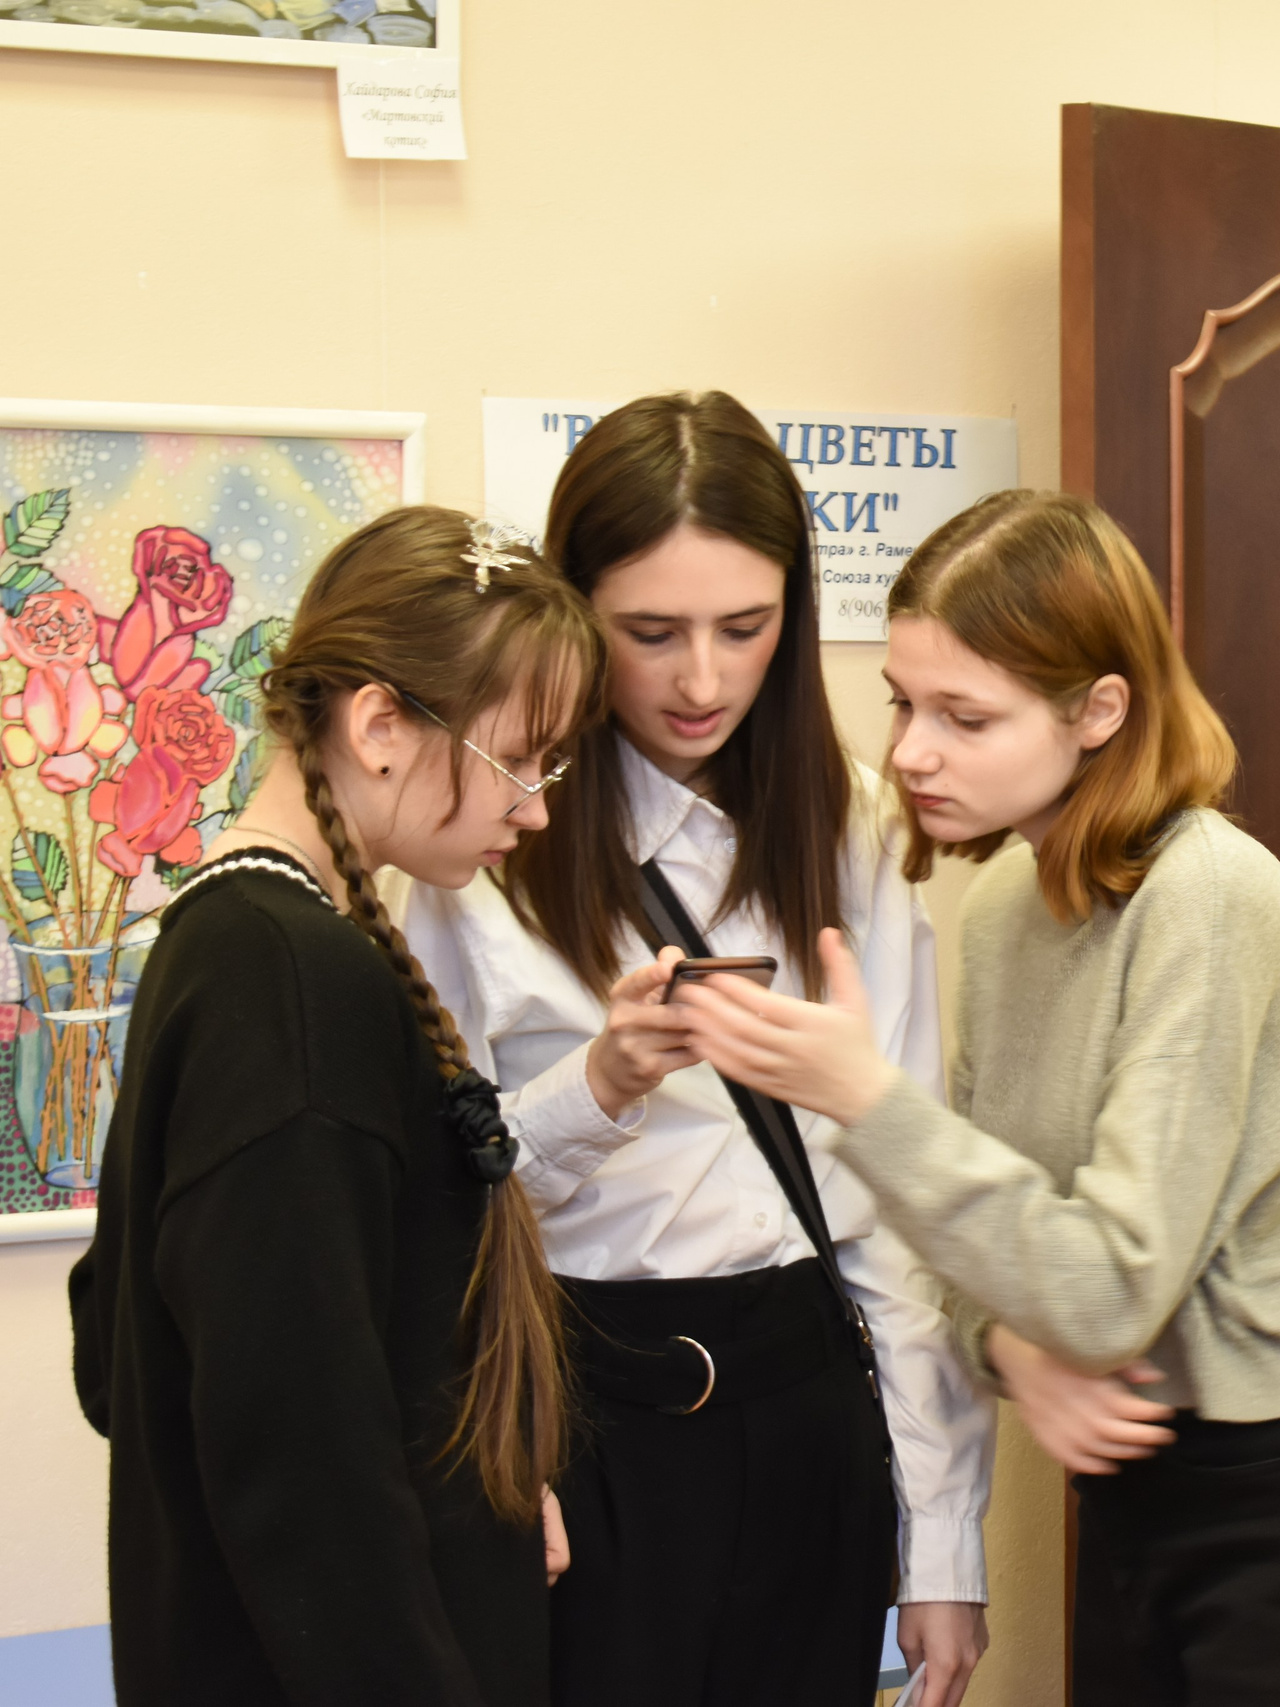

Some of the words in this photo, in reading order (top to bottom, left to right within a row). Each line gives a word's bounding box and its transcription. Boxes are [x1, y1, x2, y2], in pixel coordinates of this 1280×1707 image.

[342, 81, 412, 101] Хайдарова
[414, 83, 458, 102] София
[542, 412, 605, 456] "В
[777, 422, 958, 475] ЦВЕТЫ
[858, 546, 871, 557] г.
[875, 542, 916, 558] Раме
[822, 569, 871, 584] Союза
